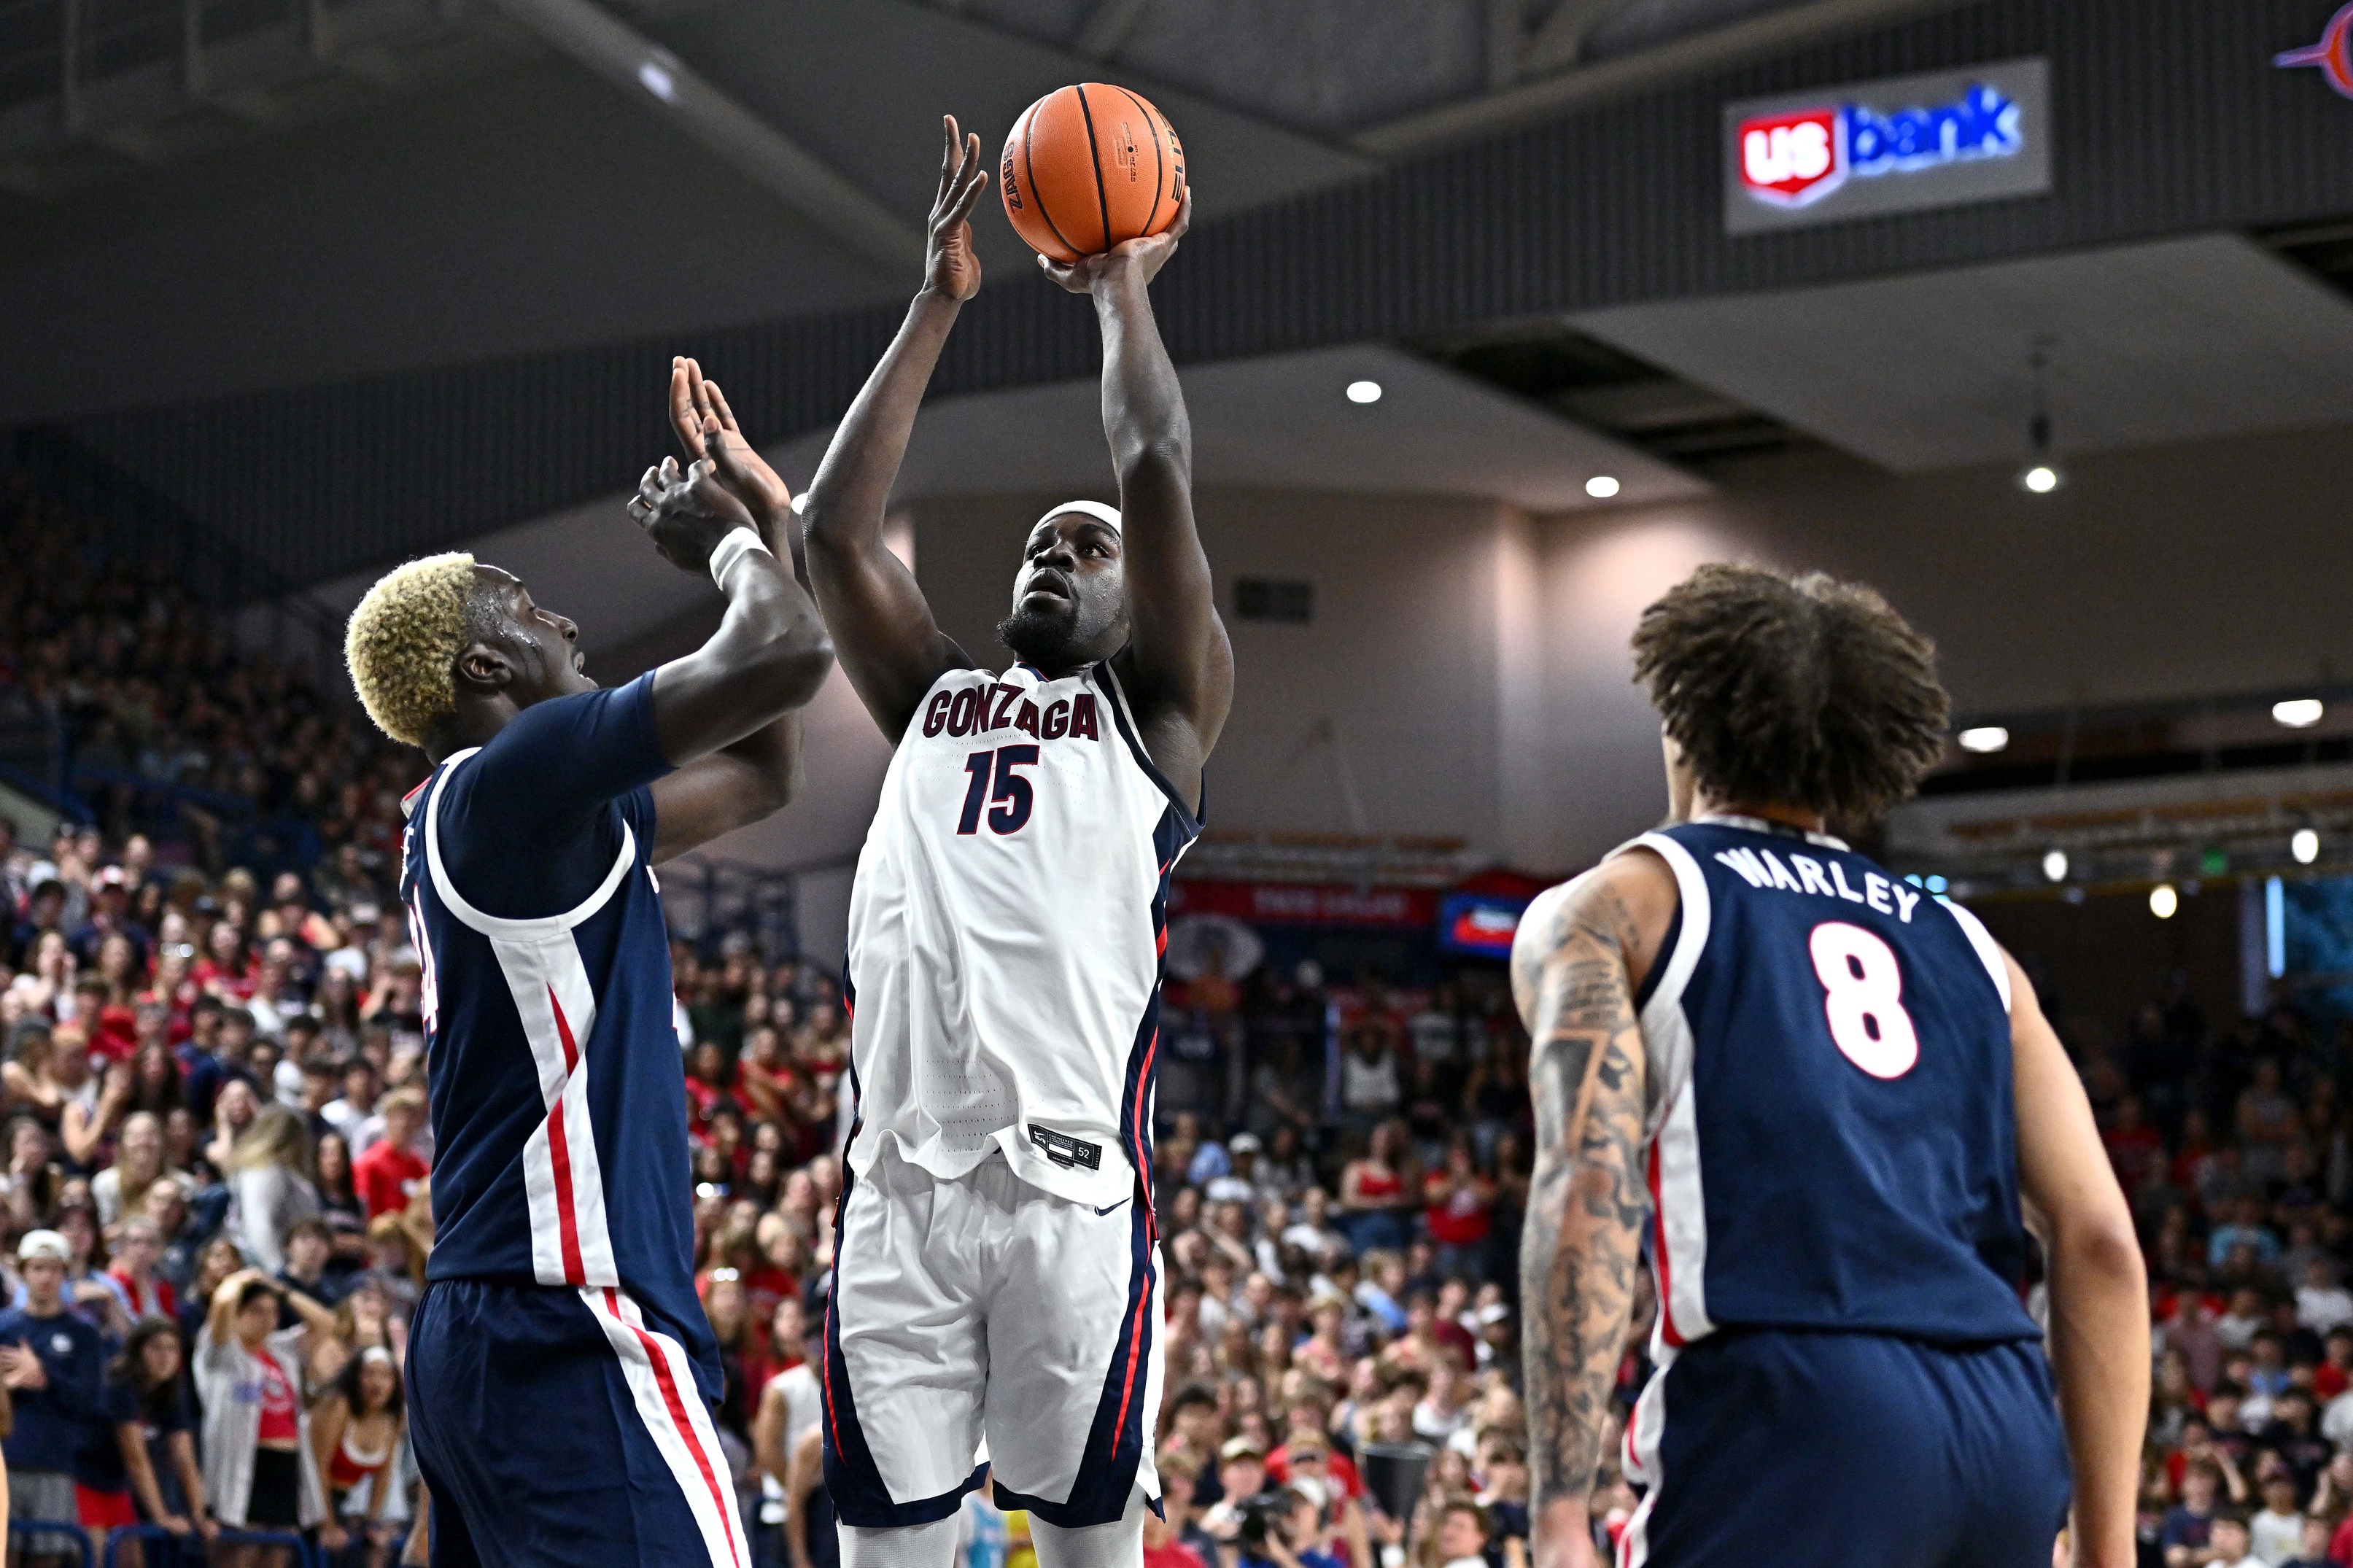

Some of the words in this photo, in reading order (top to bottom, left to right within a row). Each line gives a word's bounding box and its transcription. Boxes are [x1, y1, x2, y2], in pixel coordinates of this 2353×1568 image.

[1840, 82, 2022, 174] bank
[1002, 141, 1023, 214] ZAGS
[923, 682, 1099, 742] GONZAGA
[956, 744, 1040, 836] 15
[1714, 847, 1920, 923] WARLEY
[1807, 920, 1920, 1080] 8
[1078, 1147, 1090, 1159] 52
